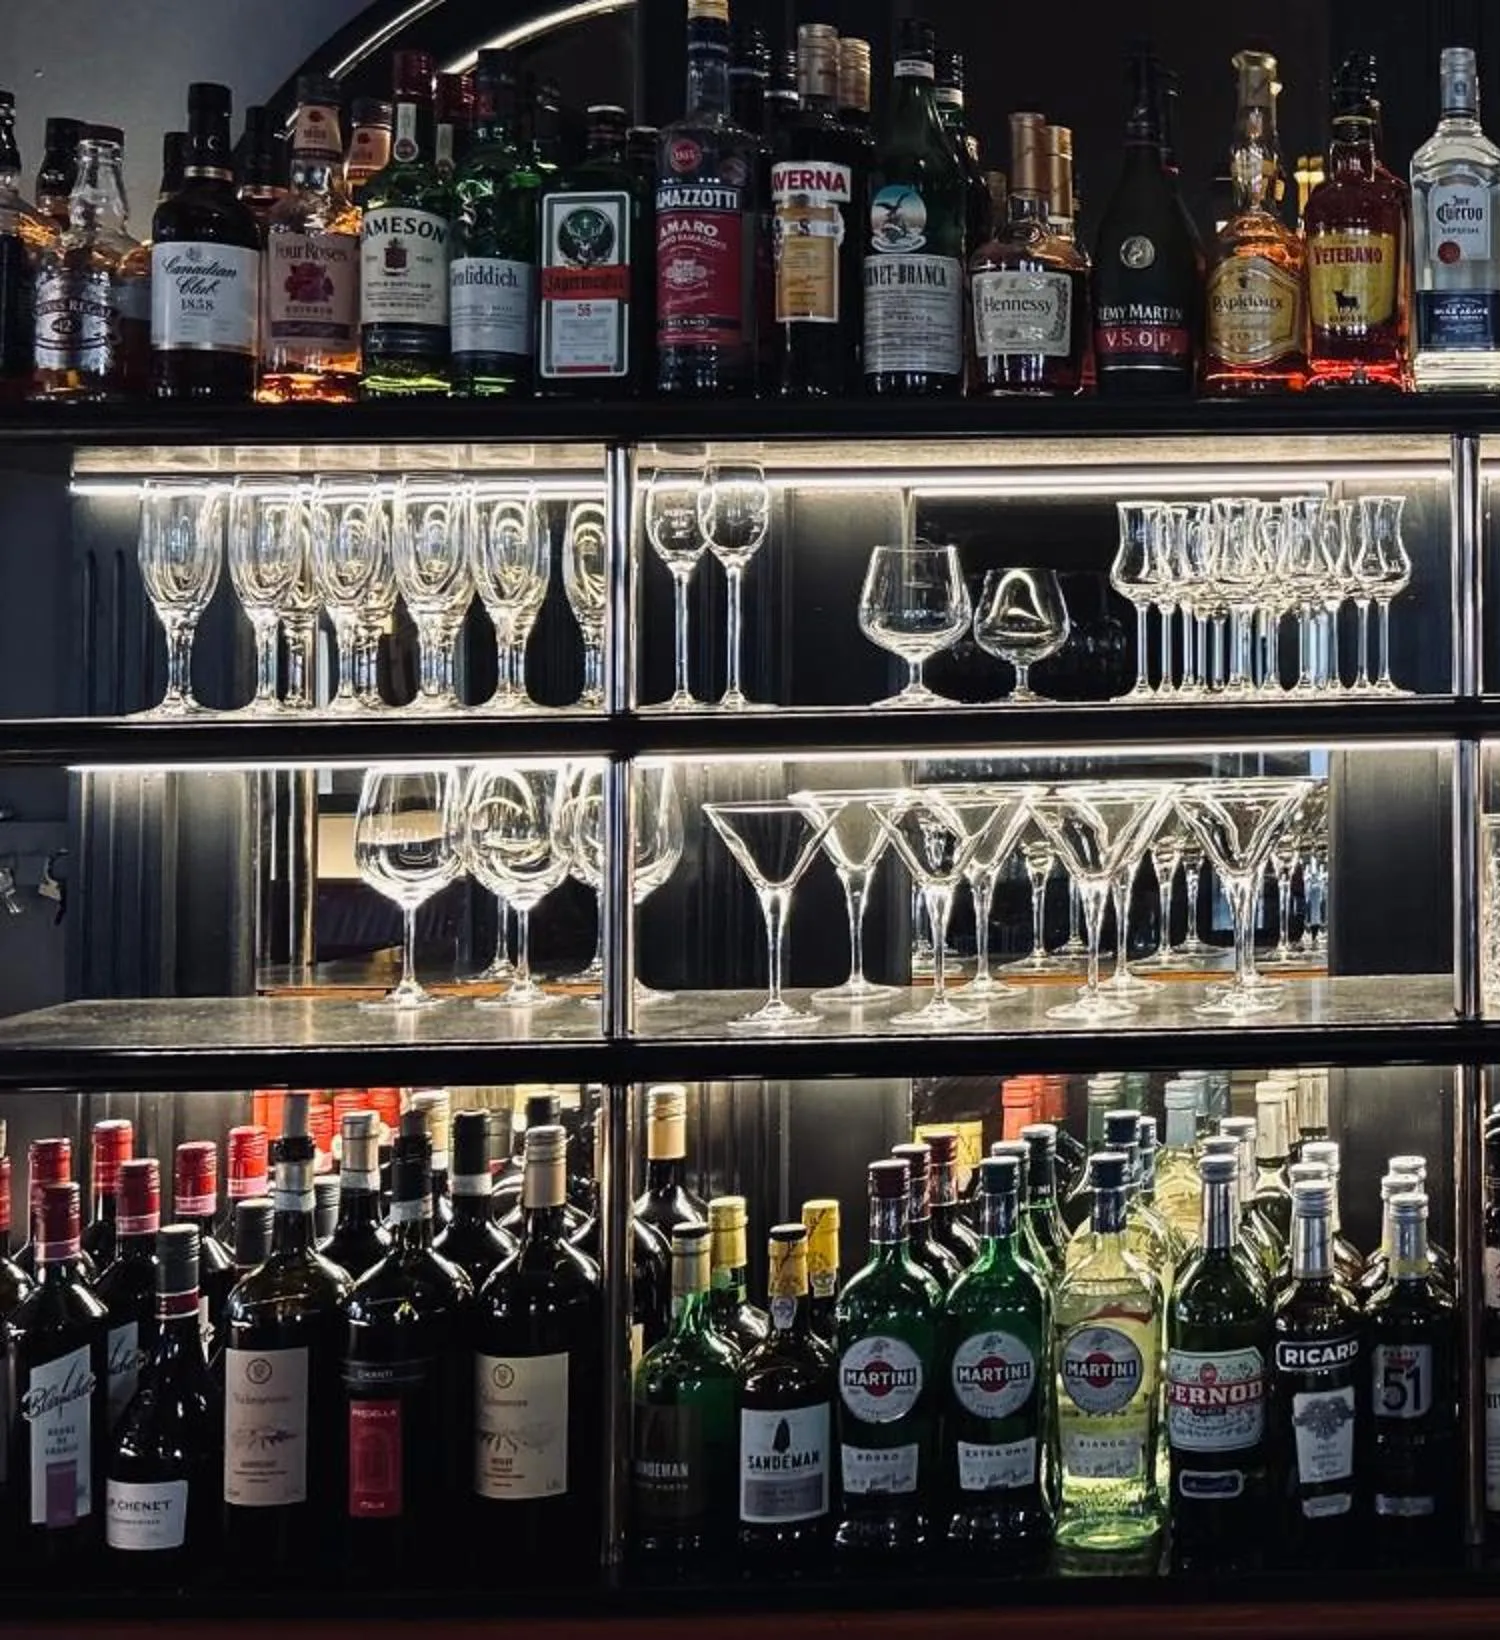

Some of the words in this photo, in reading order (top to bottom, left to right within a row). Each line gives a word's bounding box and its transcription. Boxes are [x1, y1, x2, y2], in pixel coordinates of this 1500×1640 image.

[1436, 203, 1483, 224] Cuervo
[661, 221, 717, 240] AMARO
[177, 275, 216, 297] Club
[983, 296, 1053, 315] Hennessy
[1284, 1343, 1359, 1364] RICARD
[847, 1371, 915, 1386] MARTINI
[960, 1362, 1028, 1382] MARTINI
[1067, 1360, 1135, 1378] MARTINI
[1383, 1367, 1421, 1411] 51
[747, 1451, 821, 1472] SANDEMAN
[118, 1500, 173, 1512] CHENET
